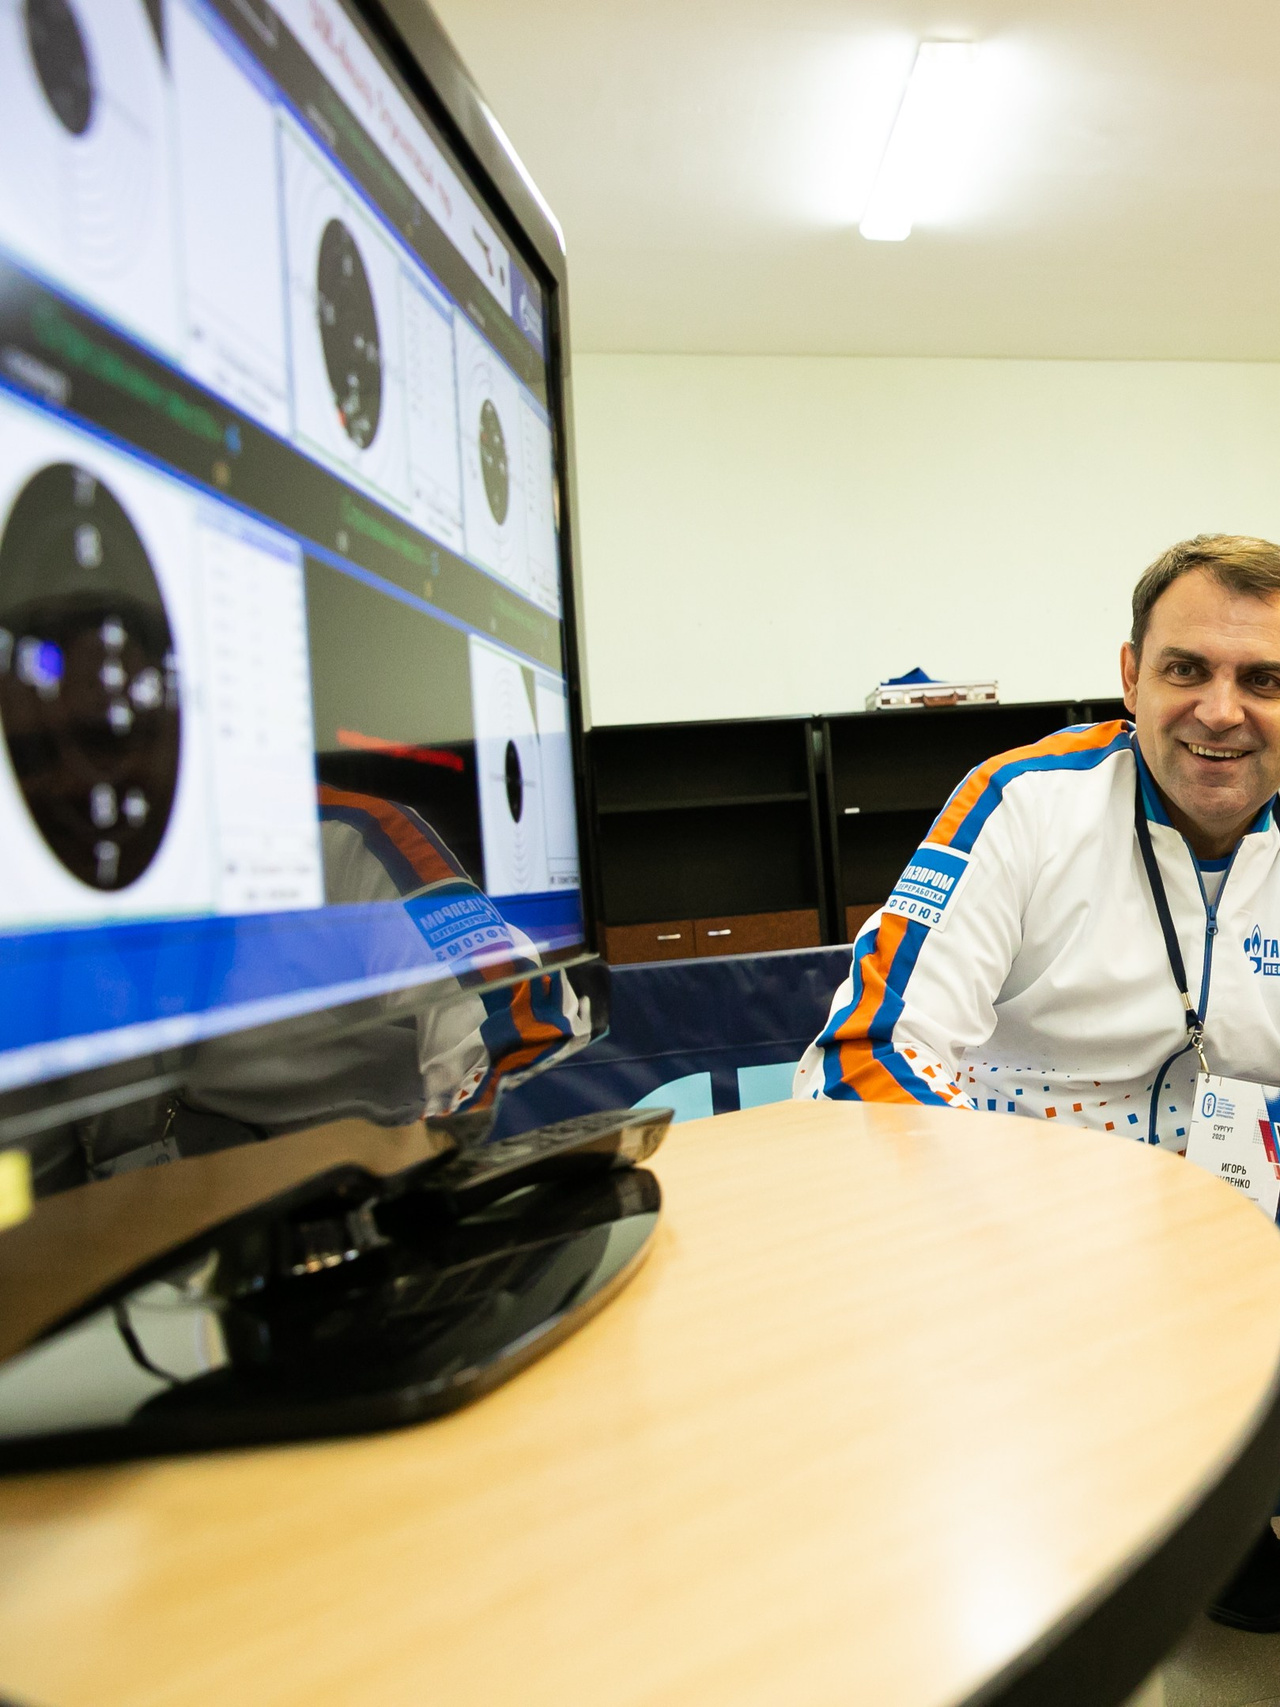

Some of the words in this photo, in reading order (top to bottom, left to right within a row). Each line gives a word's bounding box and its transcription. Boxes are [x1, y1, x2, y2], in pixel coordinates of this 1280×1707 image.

[1213, 1124, 1233, 1134] СУРГУТ
[1211, 1133, 1226, 1141] 2023
[1221, 1162, 1247, 1176] ИГОРЬ
